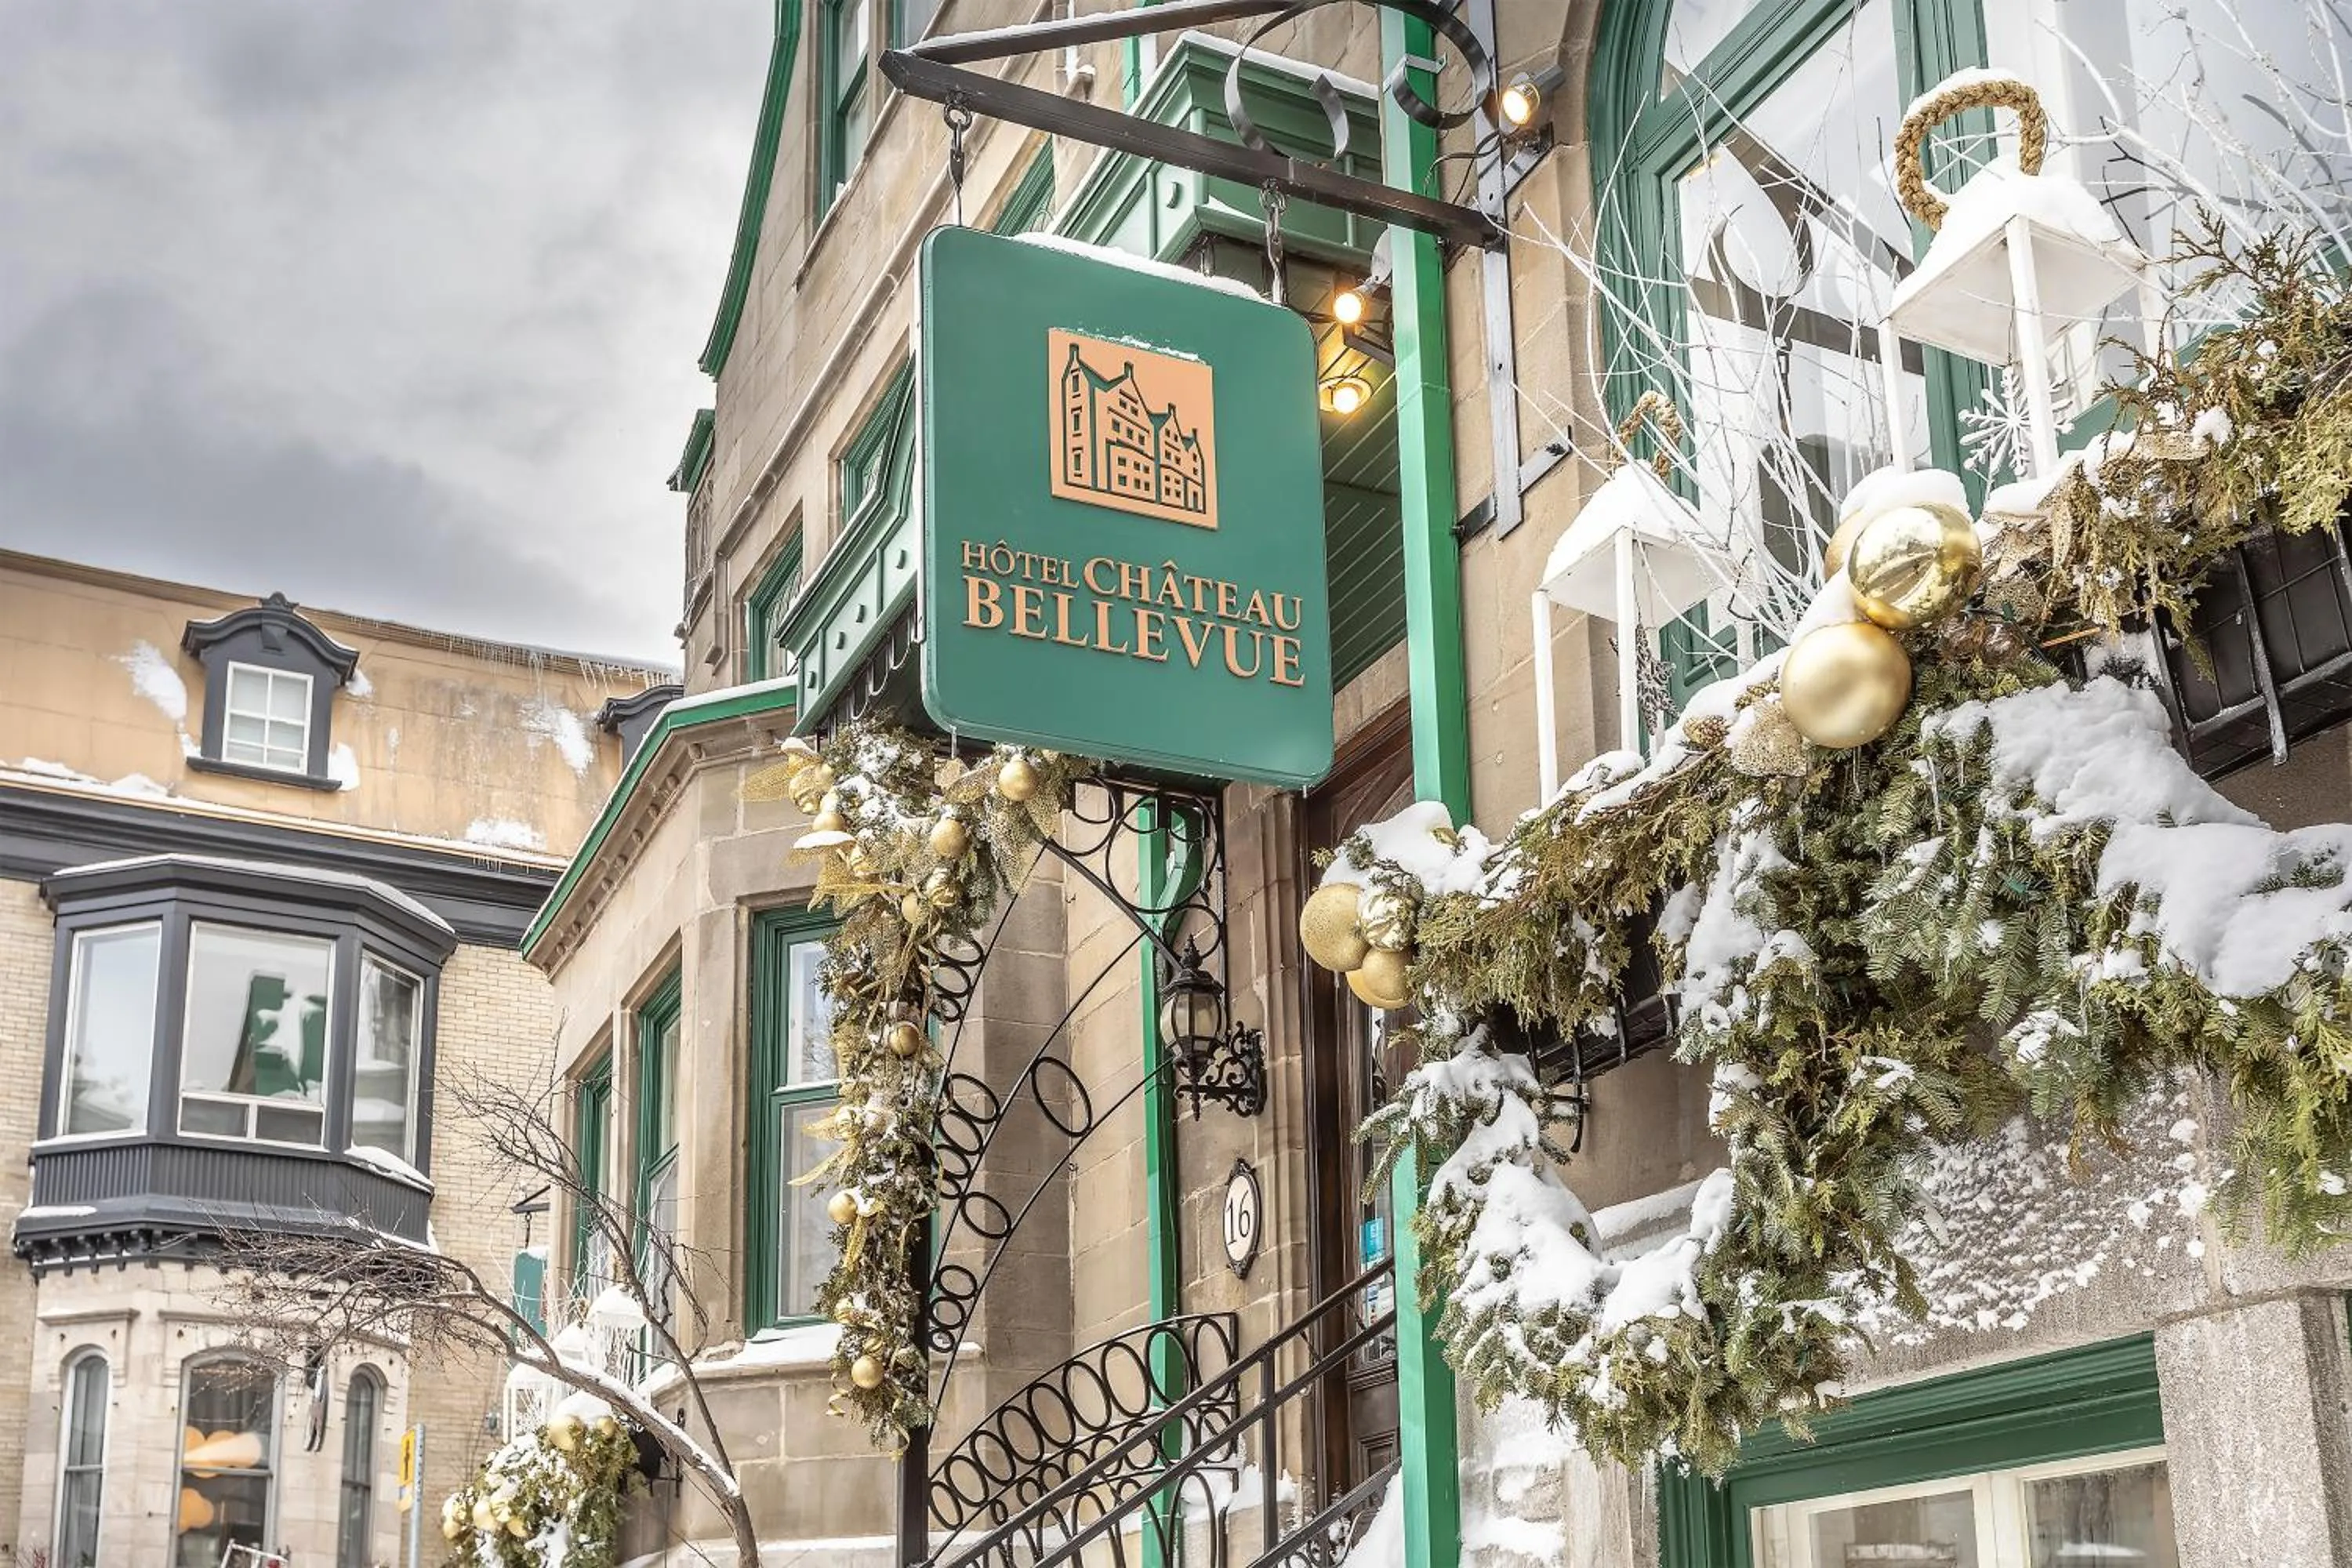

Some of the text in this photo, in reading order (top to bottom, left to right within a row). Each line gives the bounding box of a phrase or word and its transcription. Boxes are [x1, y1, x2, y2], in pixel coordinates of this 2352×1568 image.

[961, 539, 1303, 630] HÔTEL CHÂTEAU
[962, 575, 1305, 687] BELLEVUE
[1226, 1189, 1250, 1246] 16
